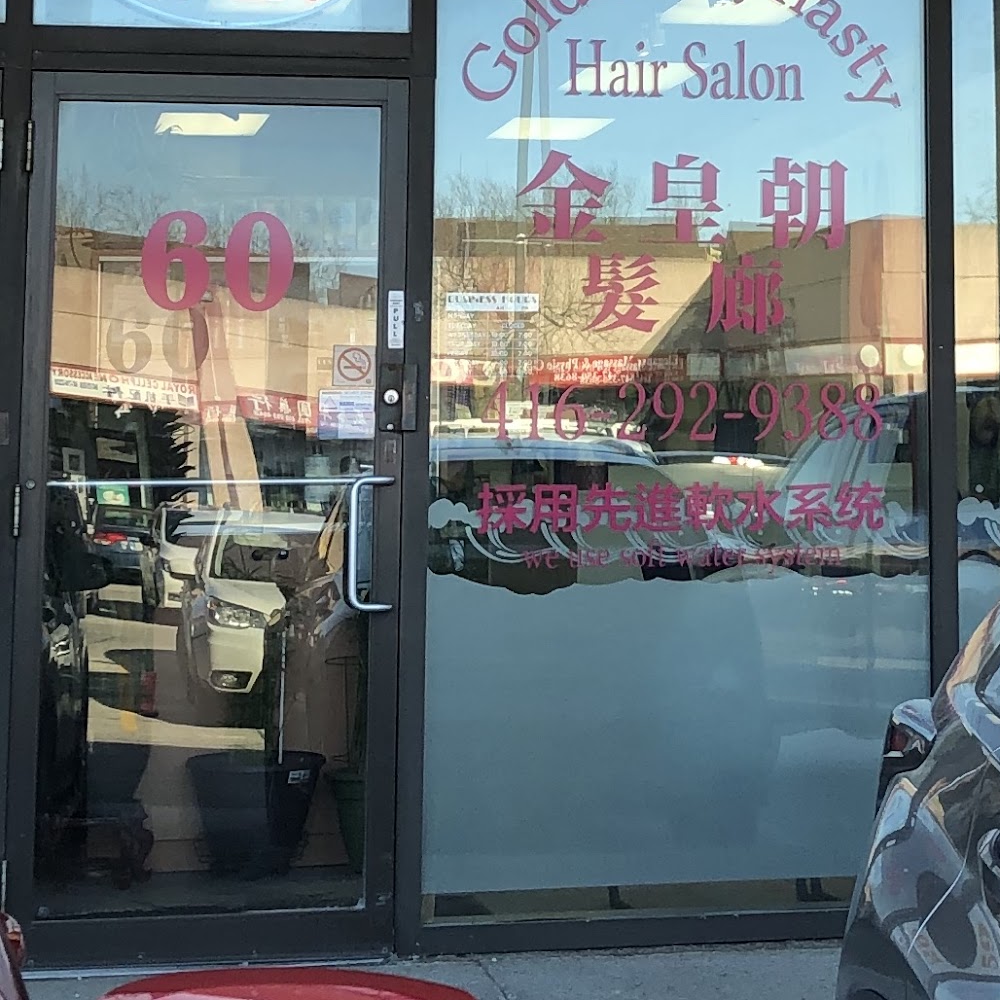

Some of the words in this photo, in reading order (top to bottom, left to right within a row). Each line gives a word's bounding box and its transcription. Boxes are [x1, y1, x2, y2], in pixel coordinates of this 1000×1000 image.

[565, 39, 667, 97] Hair
[681, 40, 804, 102] Salon
[516, 150, 848, 250] 金皇朝
[141, 210, 294, 312] 60
[581, 252, 785, 335] 髮廊
[481, 381, 883, 442] 416-292-9388
[523, 551, 559, 569] we
[569, 550, 609, 568] use
[619, 541, 666, 568] soft
[678, 543, 748, 568] water
[754, 543, 843, 574] system
